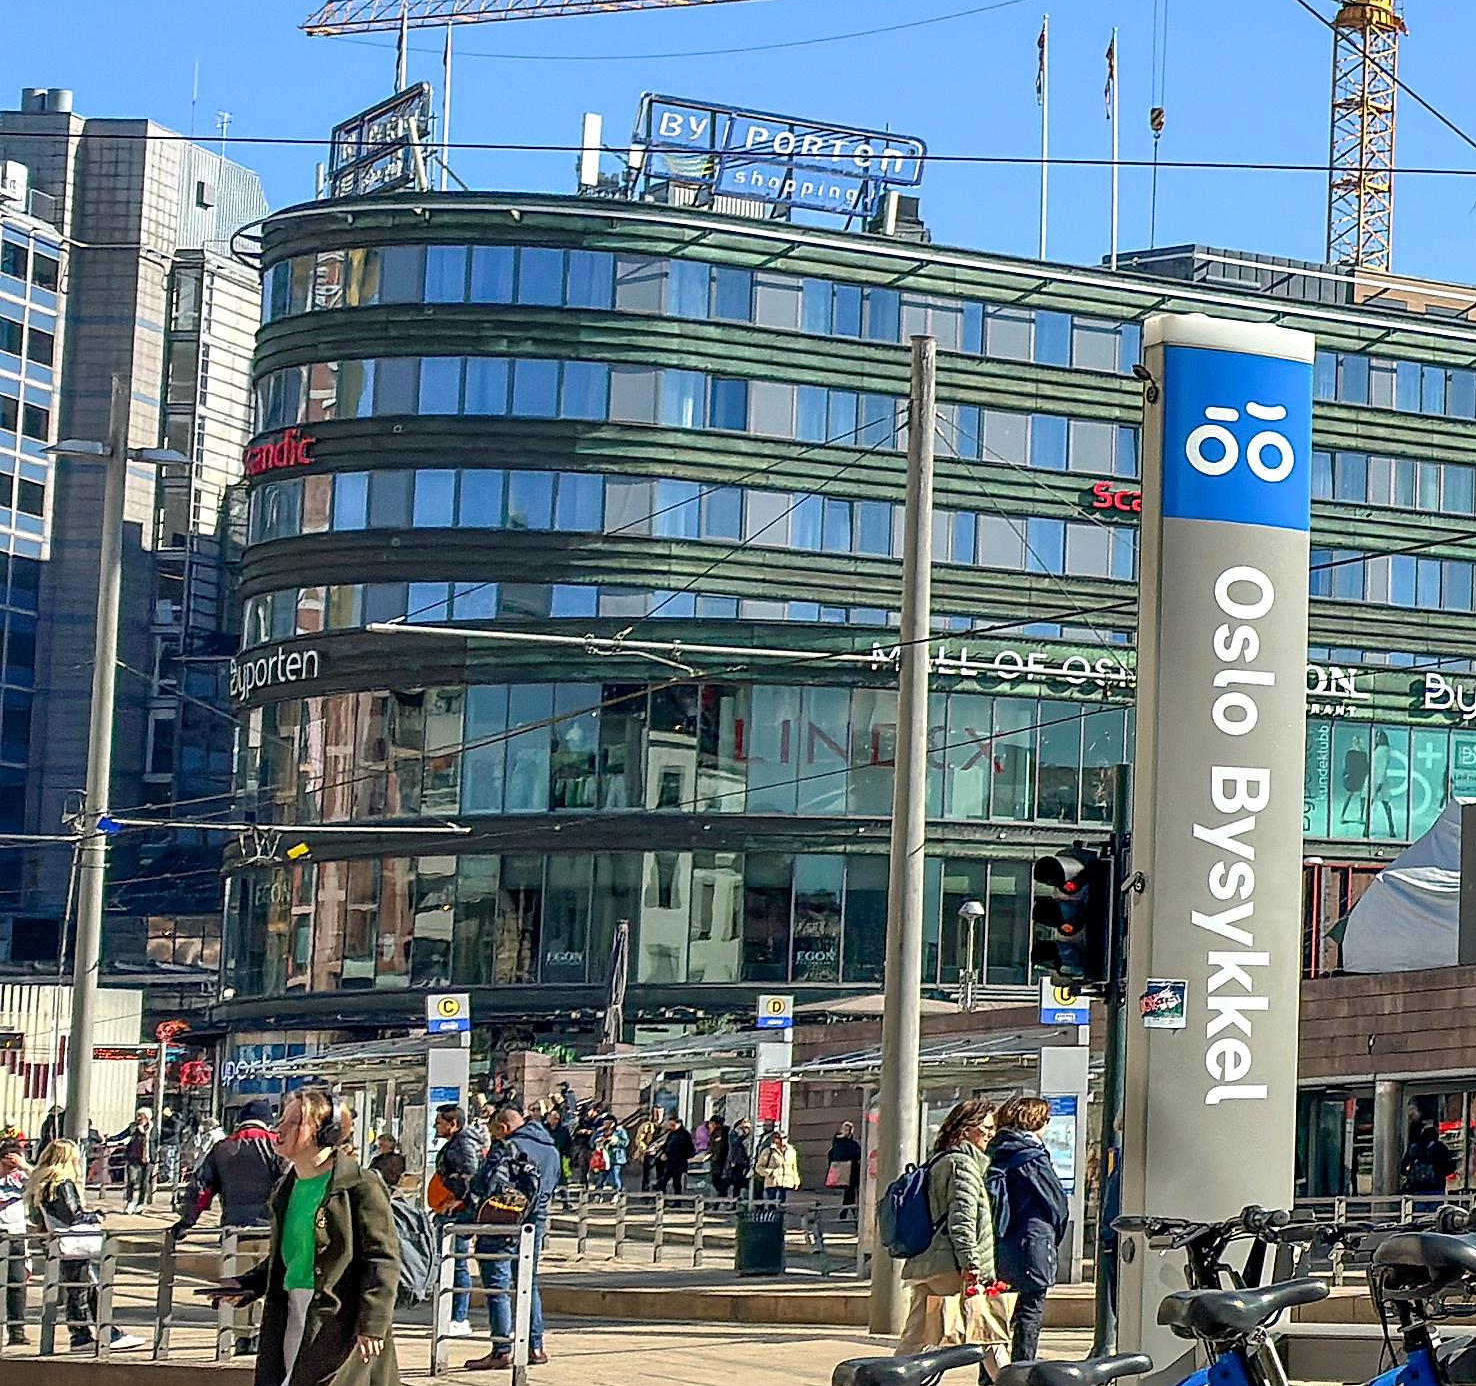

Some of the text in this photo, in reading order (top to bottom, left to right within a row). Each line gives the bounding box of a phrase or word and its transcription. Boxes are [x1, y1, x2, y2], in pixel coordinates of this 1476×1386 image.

[733, 171, 857, 202] shopping
[871, 642, 1136, 687] MLL OF OSL
[1192, 565, 1276, 1105] Oslo Bysykkel
[443, 1000, 455, 1013] C
[772, 1000, 782, 1013] D
